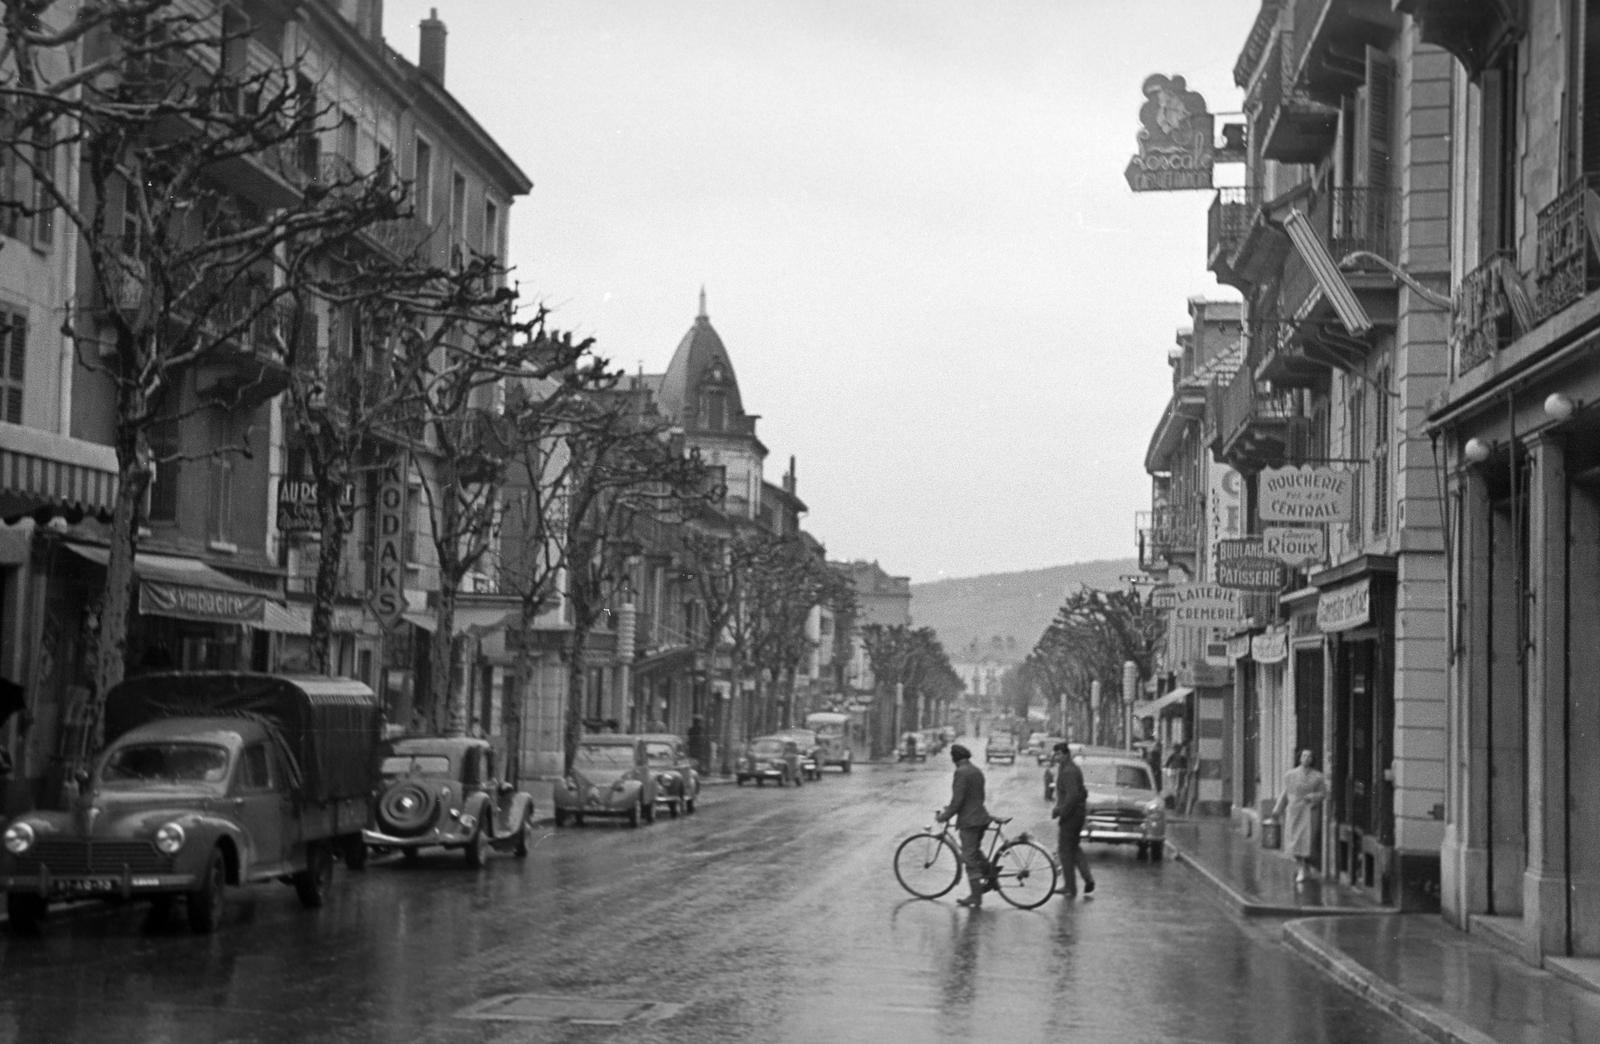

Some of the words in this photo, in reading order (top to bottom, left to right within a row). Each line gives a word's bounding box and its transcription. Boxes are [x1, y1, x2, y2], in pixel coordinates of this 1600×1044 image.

[1267, 474, 1345, 495] BOUCHERIE
[1271, 500, 1341, 518] CENTRALE
[379, 459, 401, 615] KODAKS
[1220, 541, 1263, 560] BOULANG
[1219, 565, 1281, 587] PATISSERIE
[1177, 587, 1236, 602] LAITERIE
